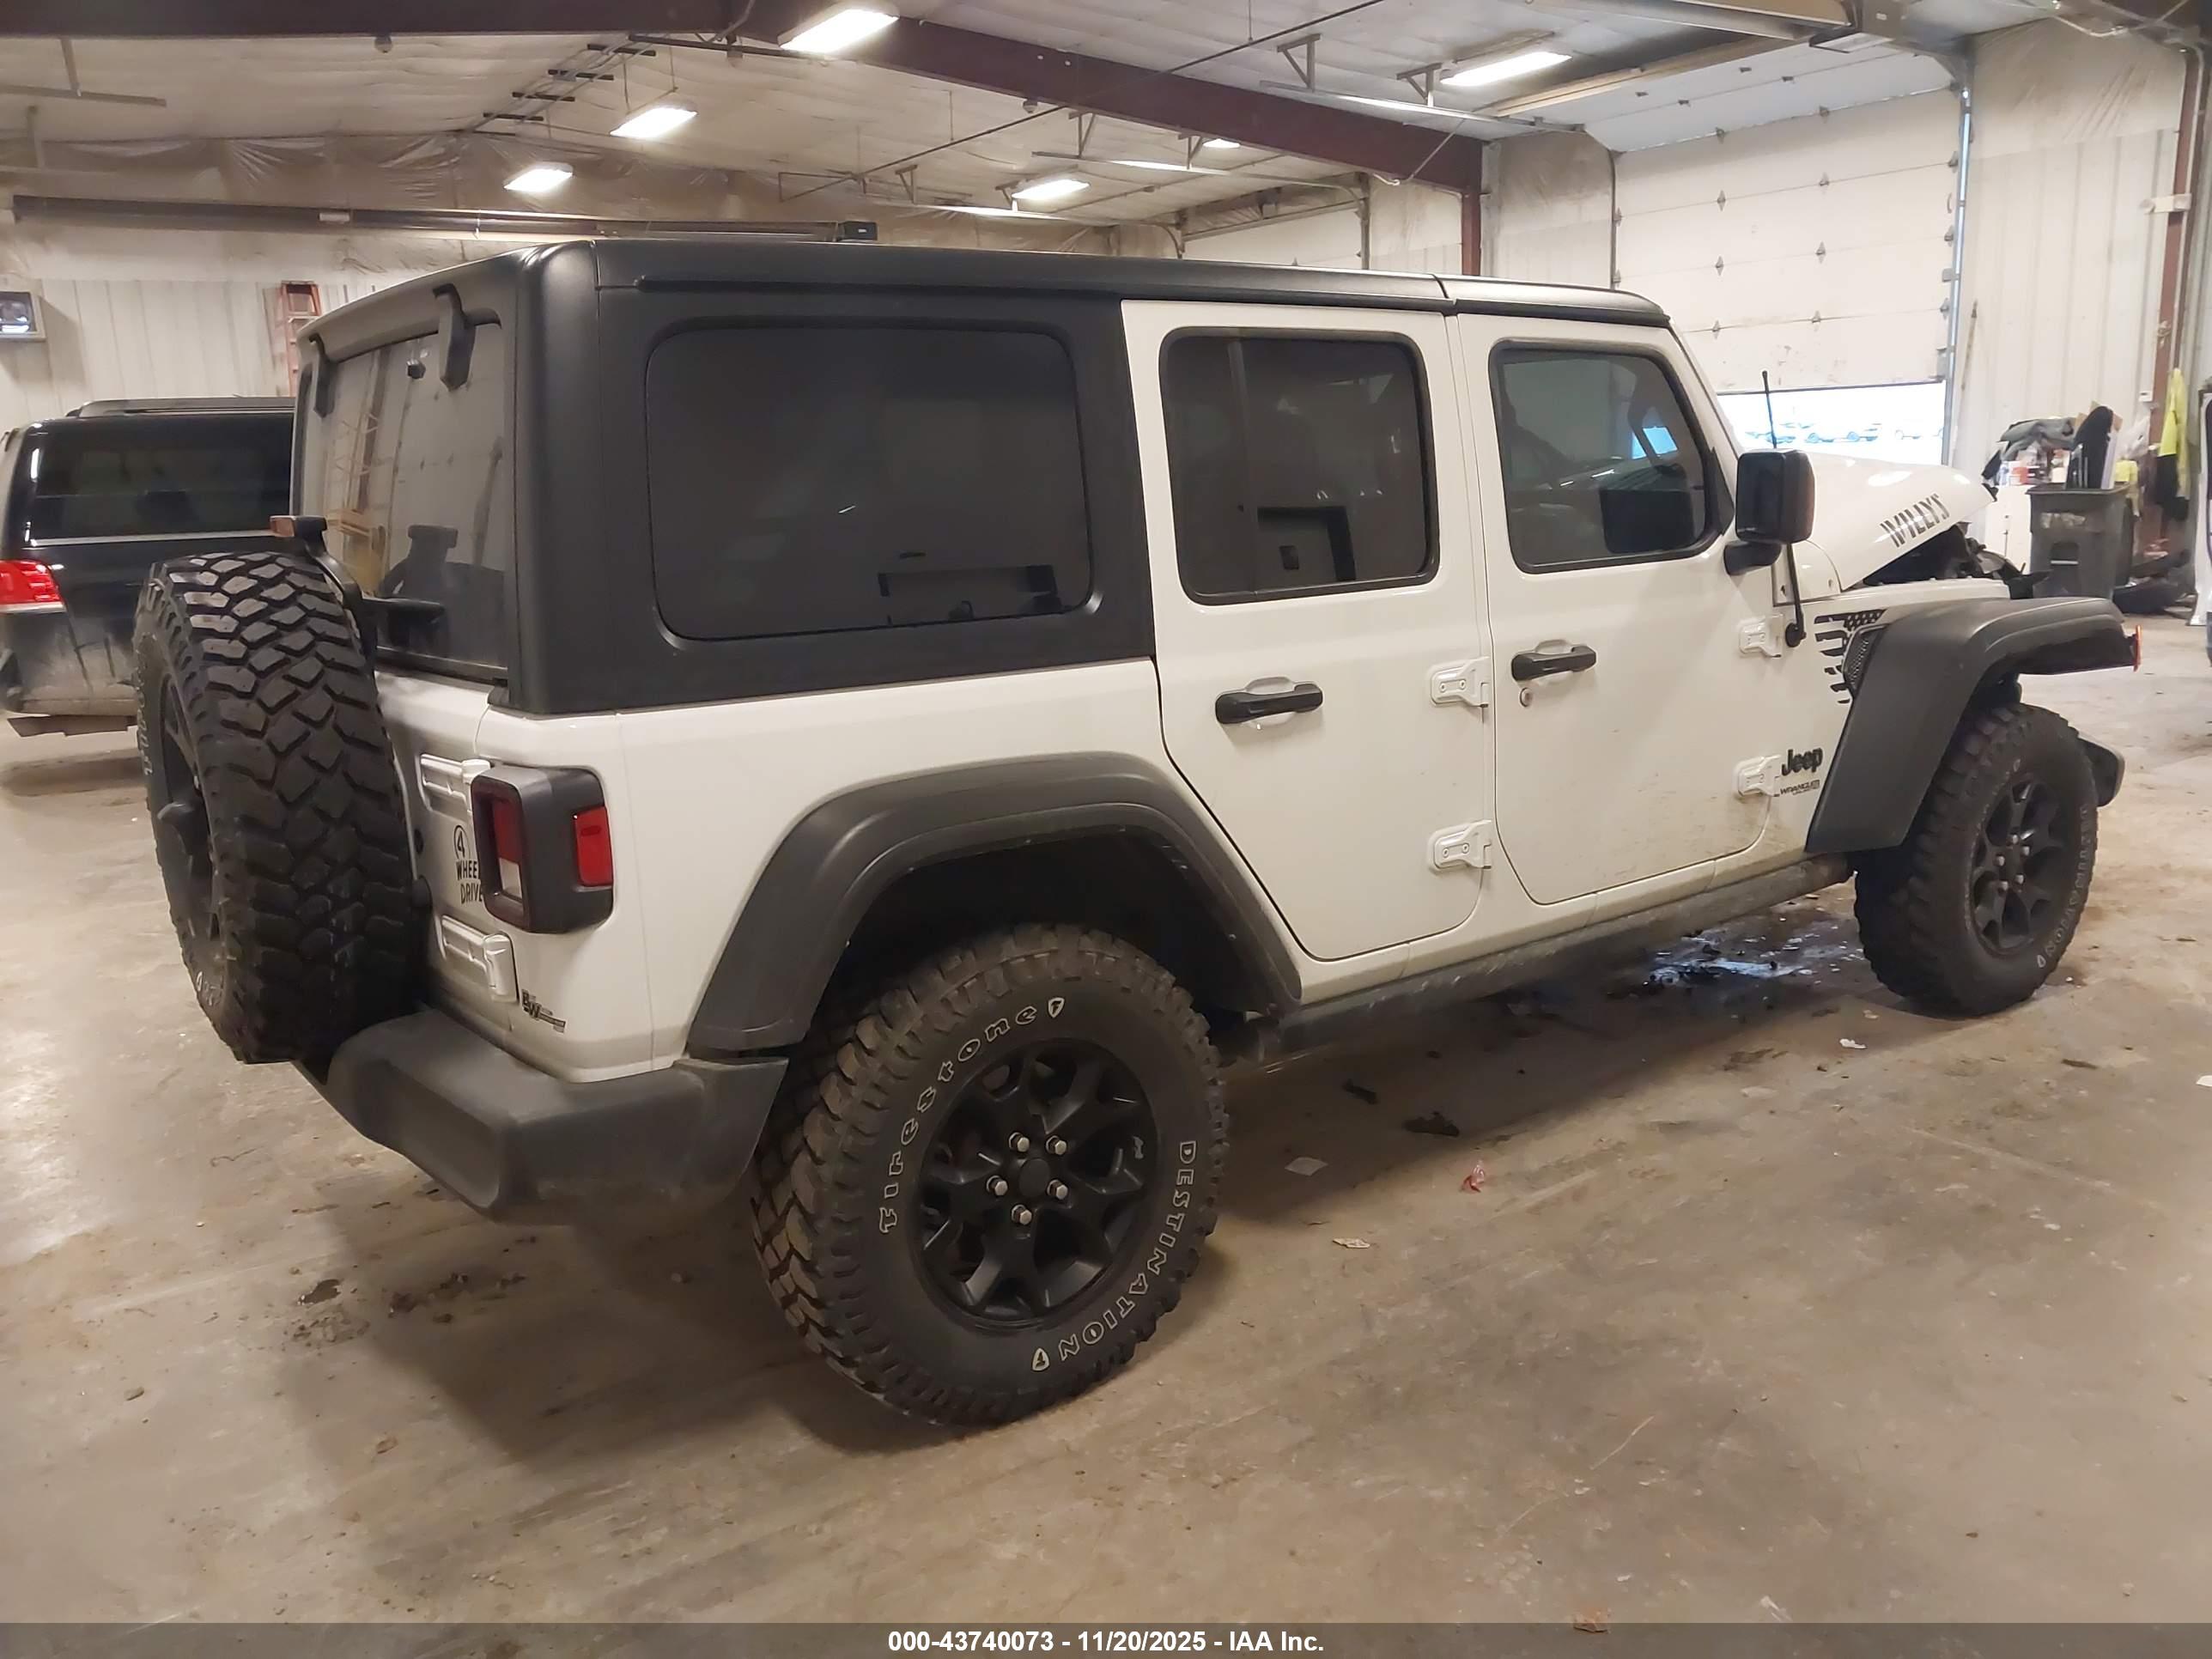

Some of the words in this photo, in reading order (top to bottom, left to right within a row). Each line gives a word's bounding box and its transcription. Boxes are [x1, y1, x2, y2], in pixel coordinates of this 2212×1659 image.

[1880, 493, 1949, 548] WILLYS
[1782, 747, 1823, 776] Jeep
[1058, 1139, 1197, 1362] DESTINATION
